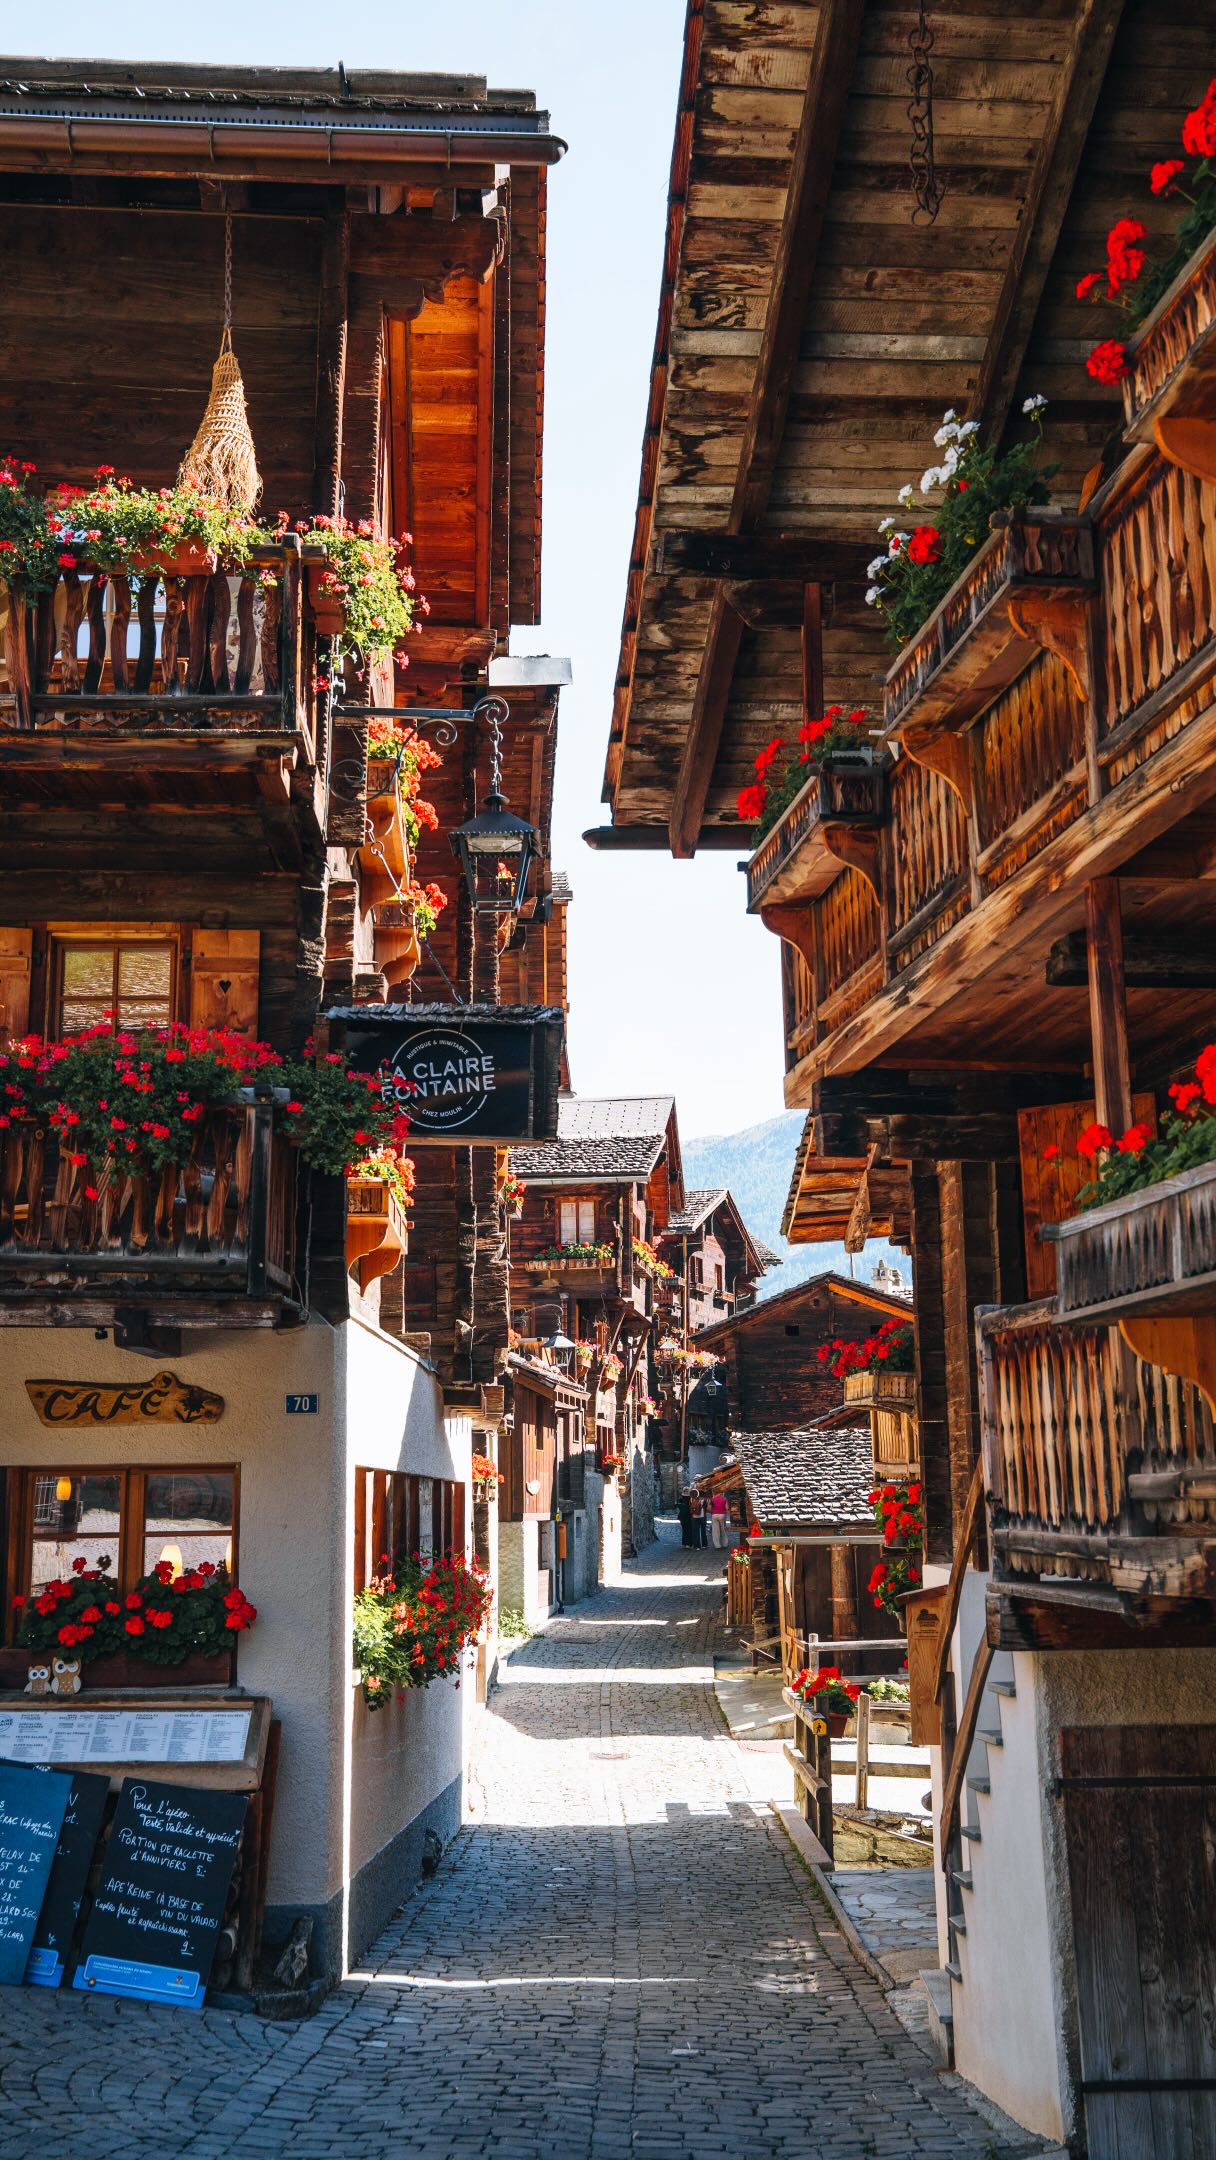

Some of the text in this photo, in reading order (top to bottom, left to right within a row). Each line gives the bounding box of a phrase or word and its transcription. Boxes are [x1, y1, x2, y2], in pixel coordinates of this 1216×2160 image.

[406, 1041, 432, 1060] RUSTIQUE
[439, 1040, 469, 1055] INIMITABLE
[413, 1055, 495, 1079] CLAIRE
[380, 1075, 497, 1102] FONTAINE
[422, 1106, 462, 1118] CHEZ MOULIN
[294, 1396, 310, 1412] 70
[130, 1786, 153, 1813] Pour
[195, 1828, 205, 1838] et
[29, 1851, 43, 1863] DE
[160, 1843, 172, 1854] DE
[174, 1846, 215, 1862] RACLETTE
[168, 1896, 190, 1910] BASE
[191, 1902, 205, 1912] DE
[160, 1908, 174, 1919] VIN
[177, 1911, 189, 1922] DU
